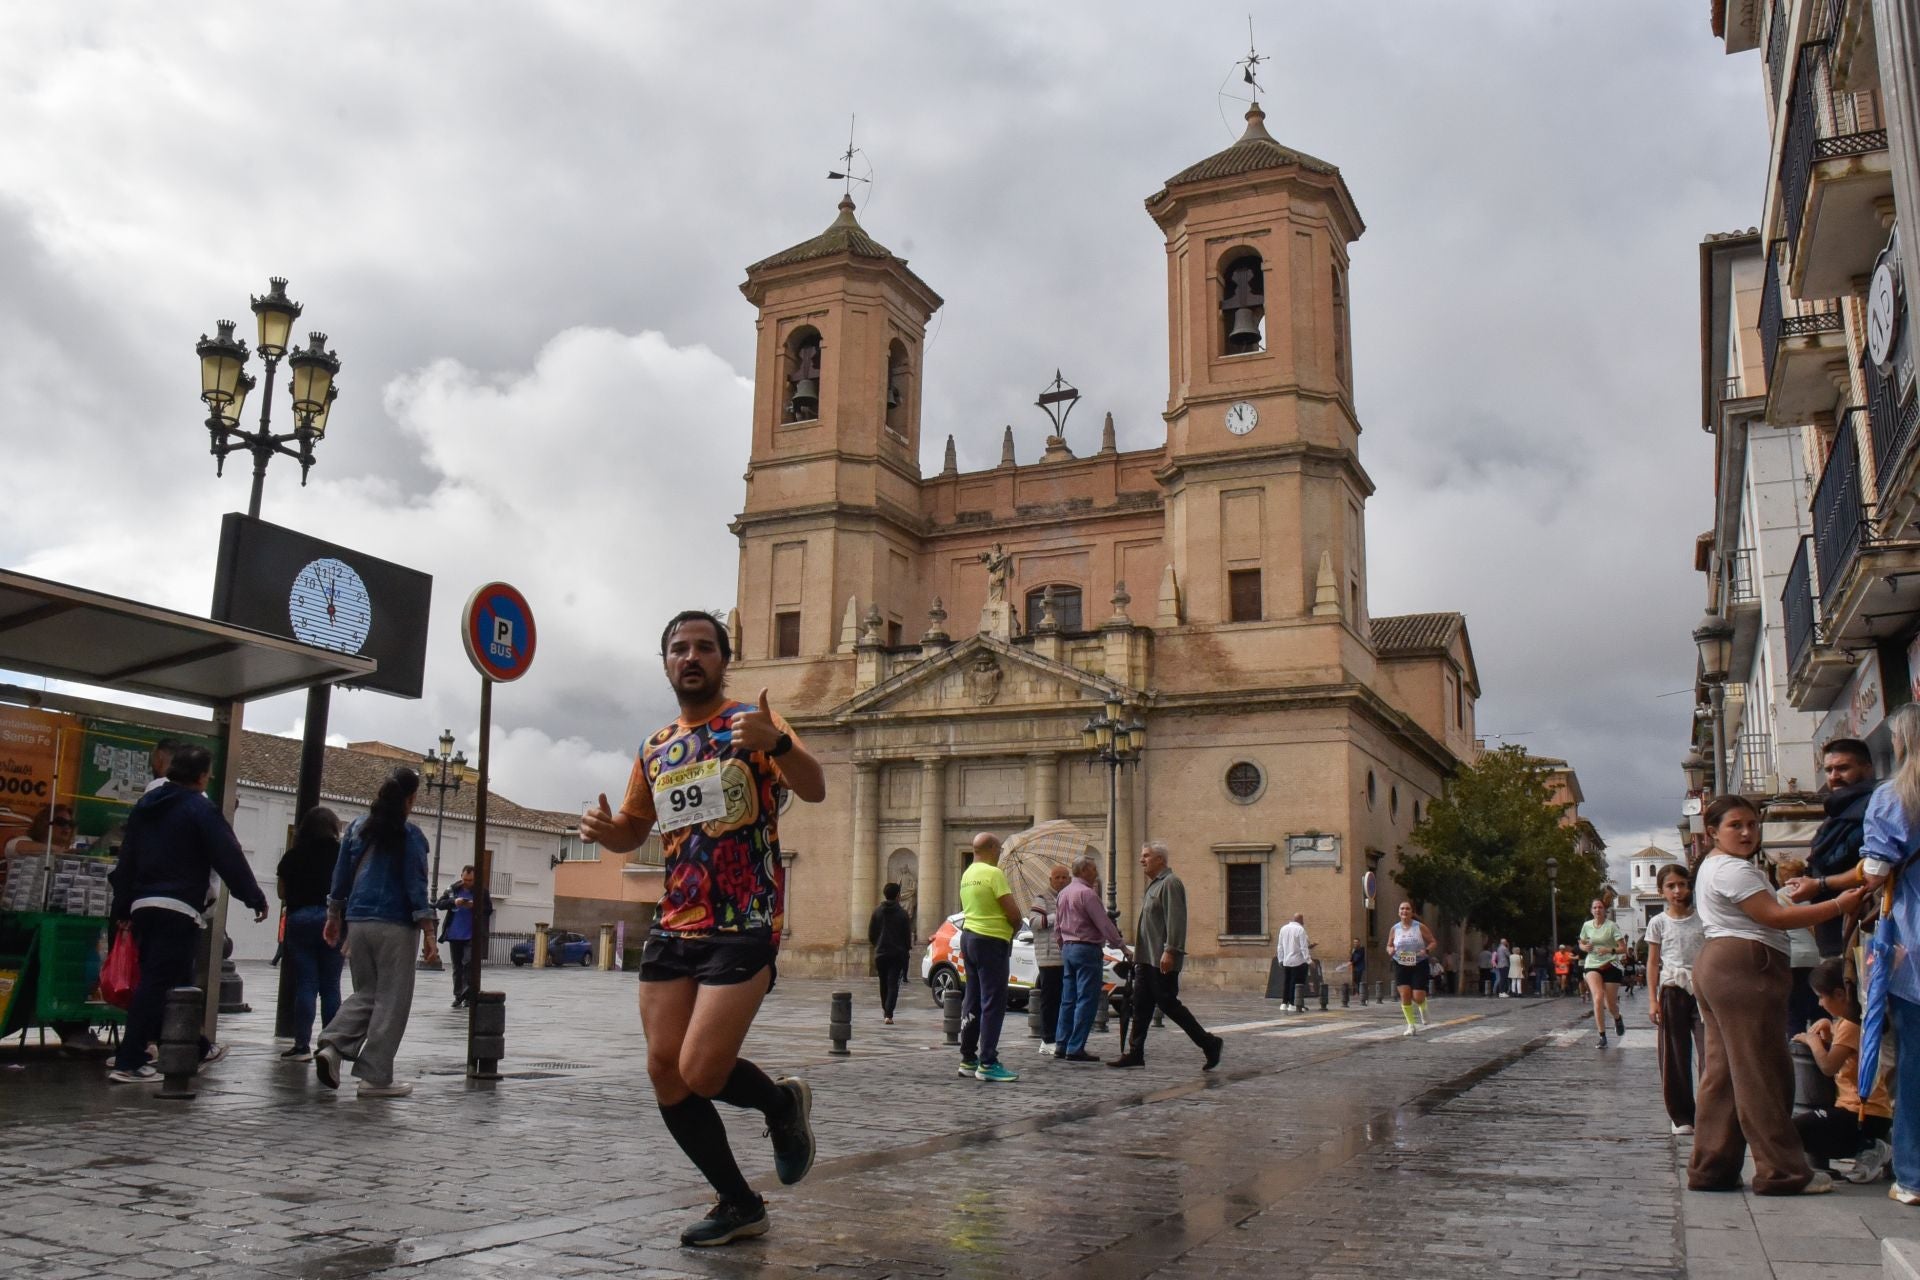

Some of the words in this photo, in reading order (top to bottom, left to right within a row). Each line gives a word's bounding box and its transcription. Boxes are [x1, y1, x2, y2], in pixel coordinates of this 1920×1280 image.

[332, 566, 342, 578] 12
[304, 578, 316, 590] 10
[298, 596, 304, 607] 9
[498, 621, 509, 640] P
[490, 643, 512, 658] BUS
[2, 730, 35, 744] Santa
[38, 735, 51, 746] Fe
[670, 785, 702, 812] 99
